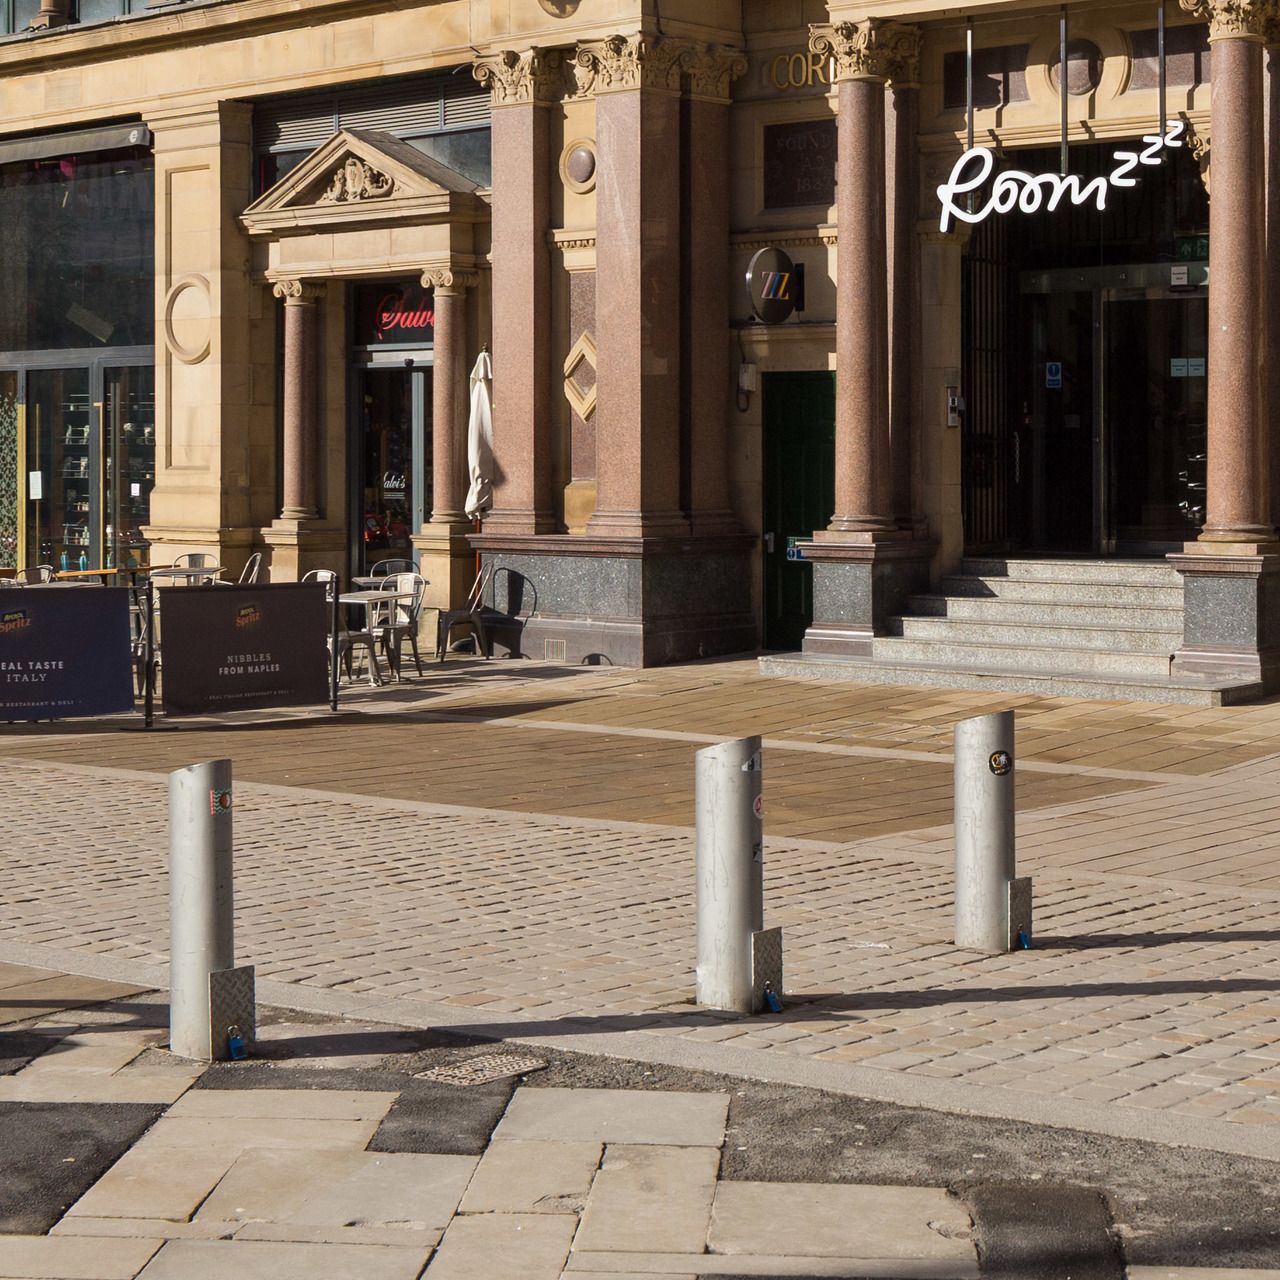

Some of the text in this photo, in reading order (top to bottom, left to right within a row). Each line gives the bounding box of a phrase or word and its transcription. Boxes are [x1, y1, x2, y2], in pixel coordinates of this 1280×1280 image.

[227, 652, 272, 663] NIBBLES
[28, 660, 65, 670] TASTE
[218, 663, 281, 676] FROM NAPLES
[6, 672, 48, 683] ITALY
